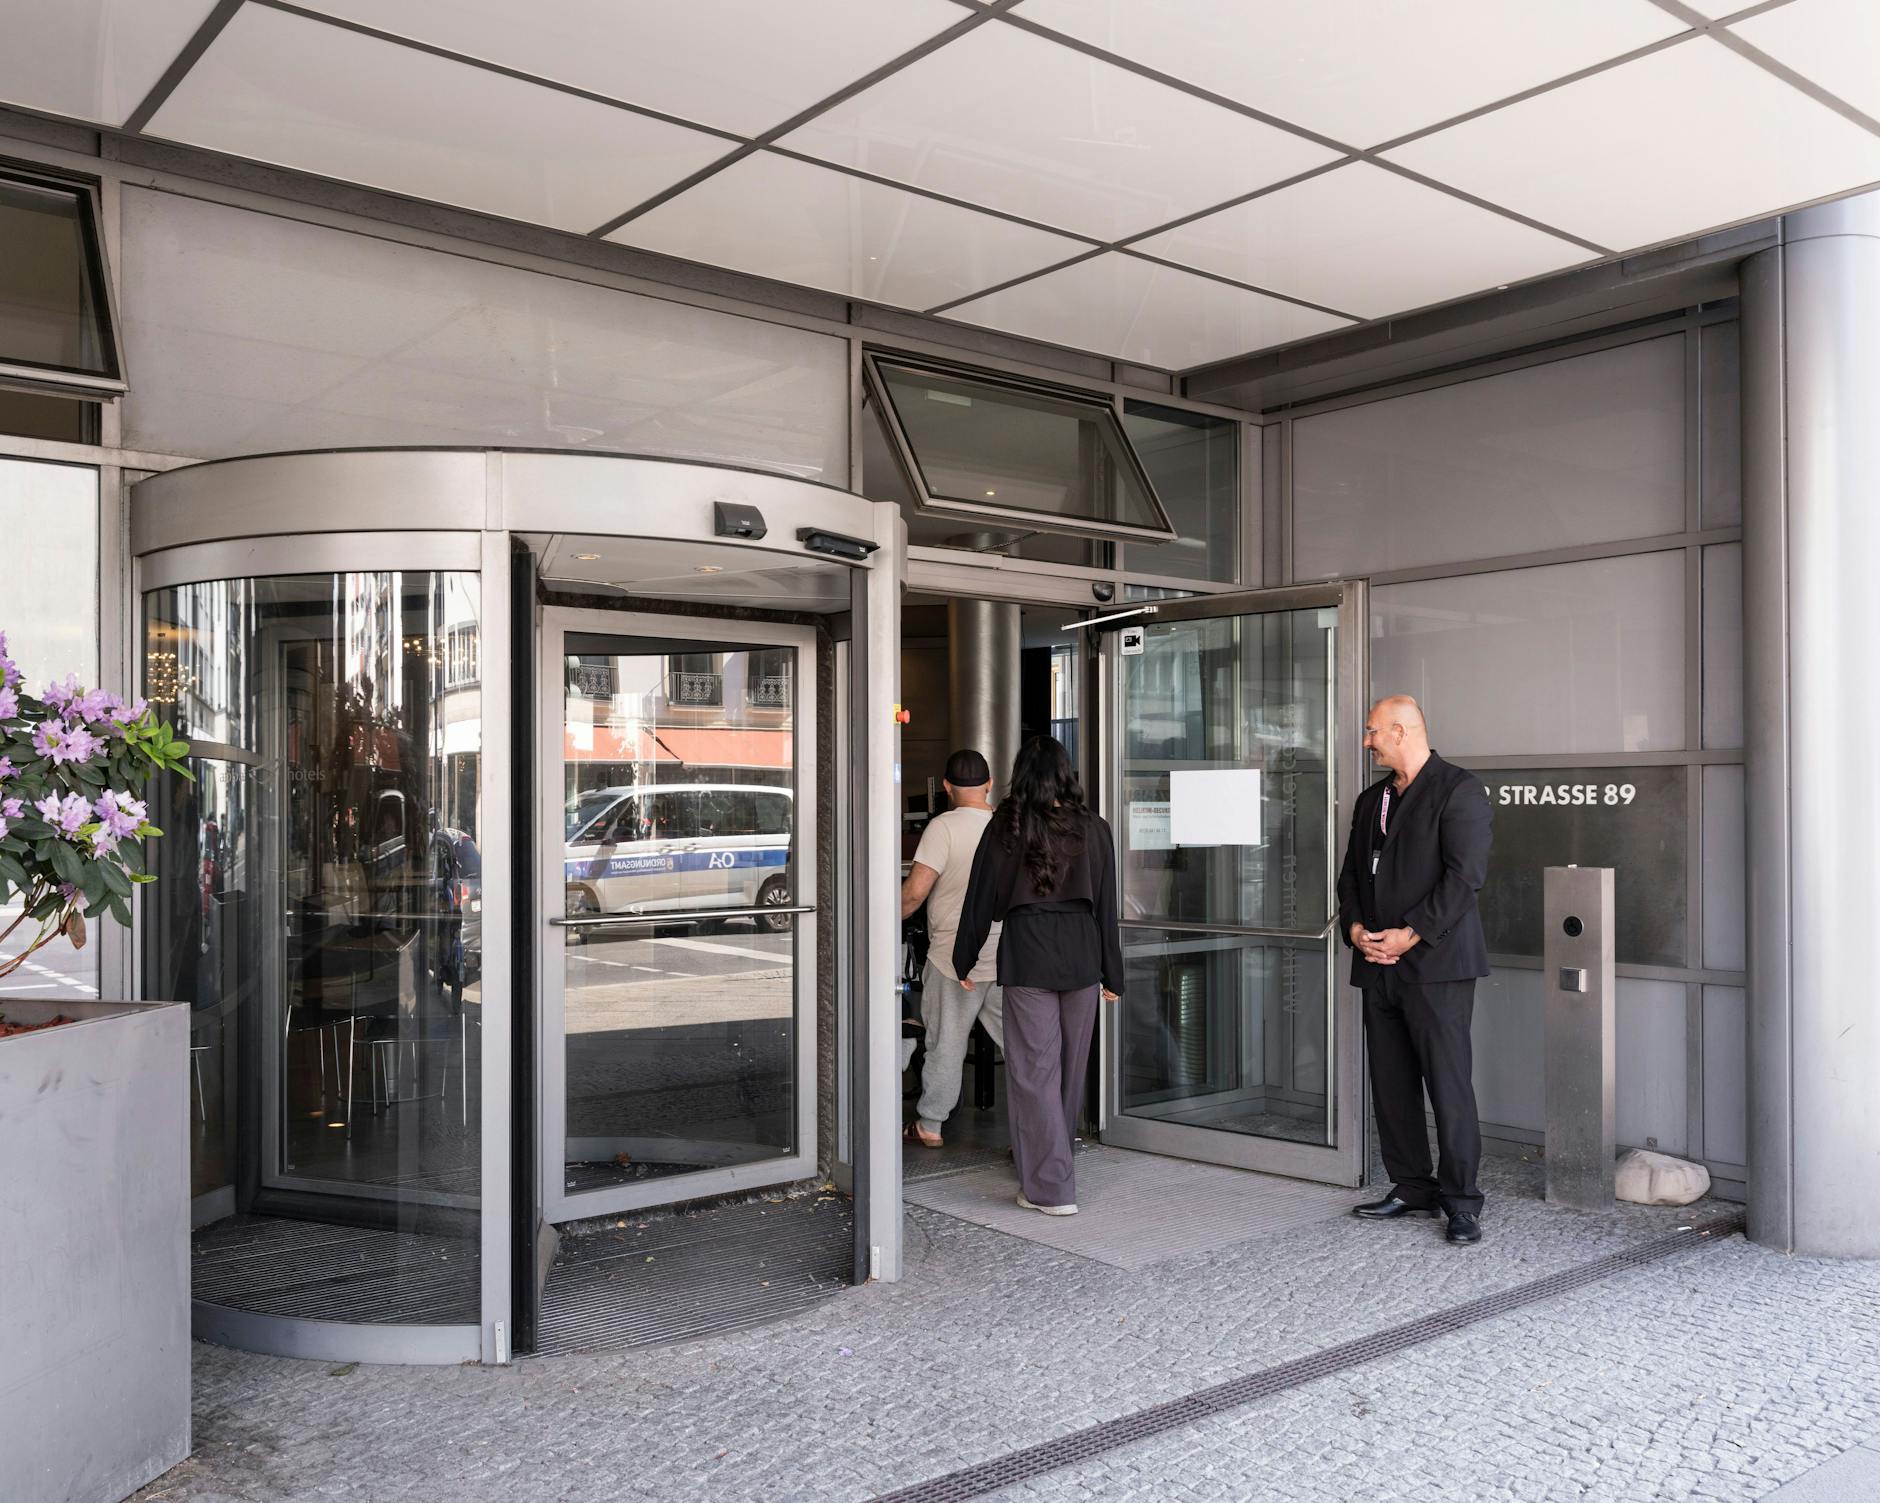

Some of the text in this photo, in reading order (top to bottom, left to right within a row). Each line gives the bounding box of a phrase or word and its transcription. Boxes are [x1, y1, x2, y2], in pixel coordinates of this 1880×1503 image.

[287, 763, 326, 781] hotels
[1499, 784, 1598, 805] STRASSE
[1604, 783, 1636, 805] 89
